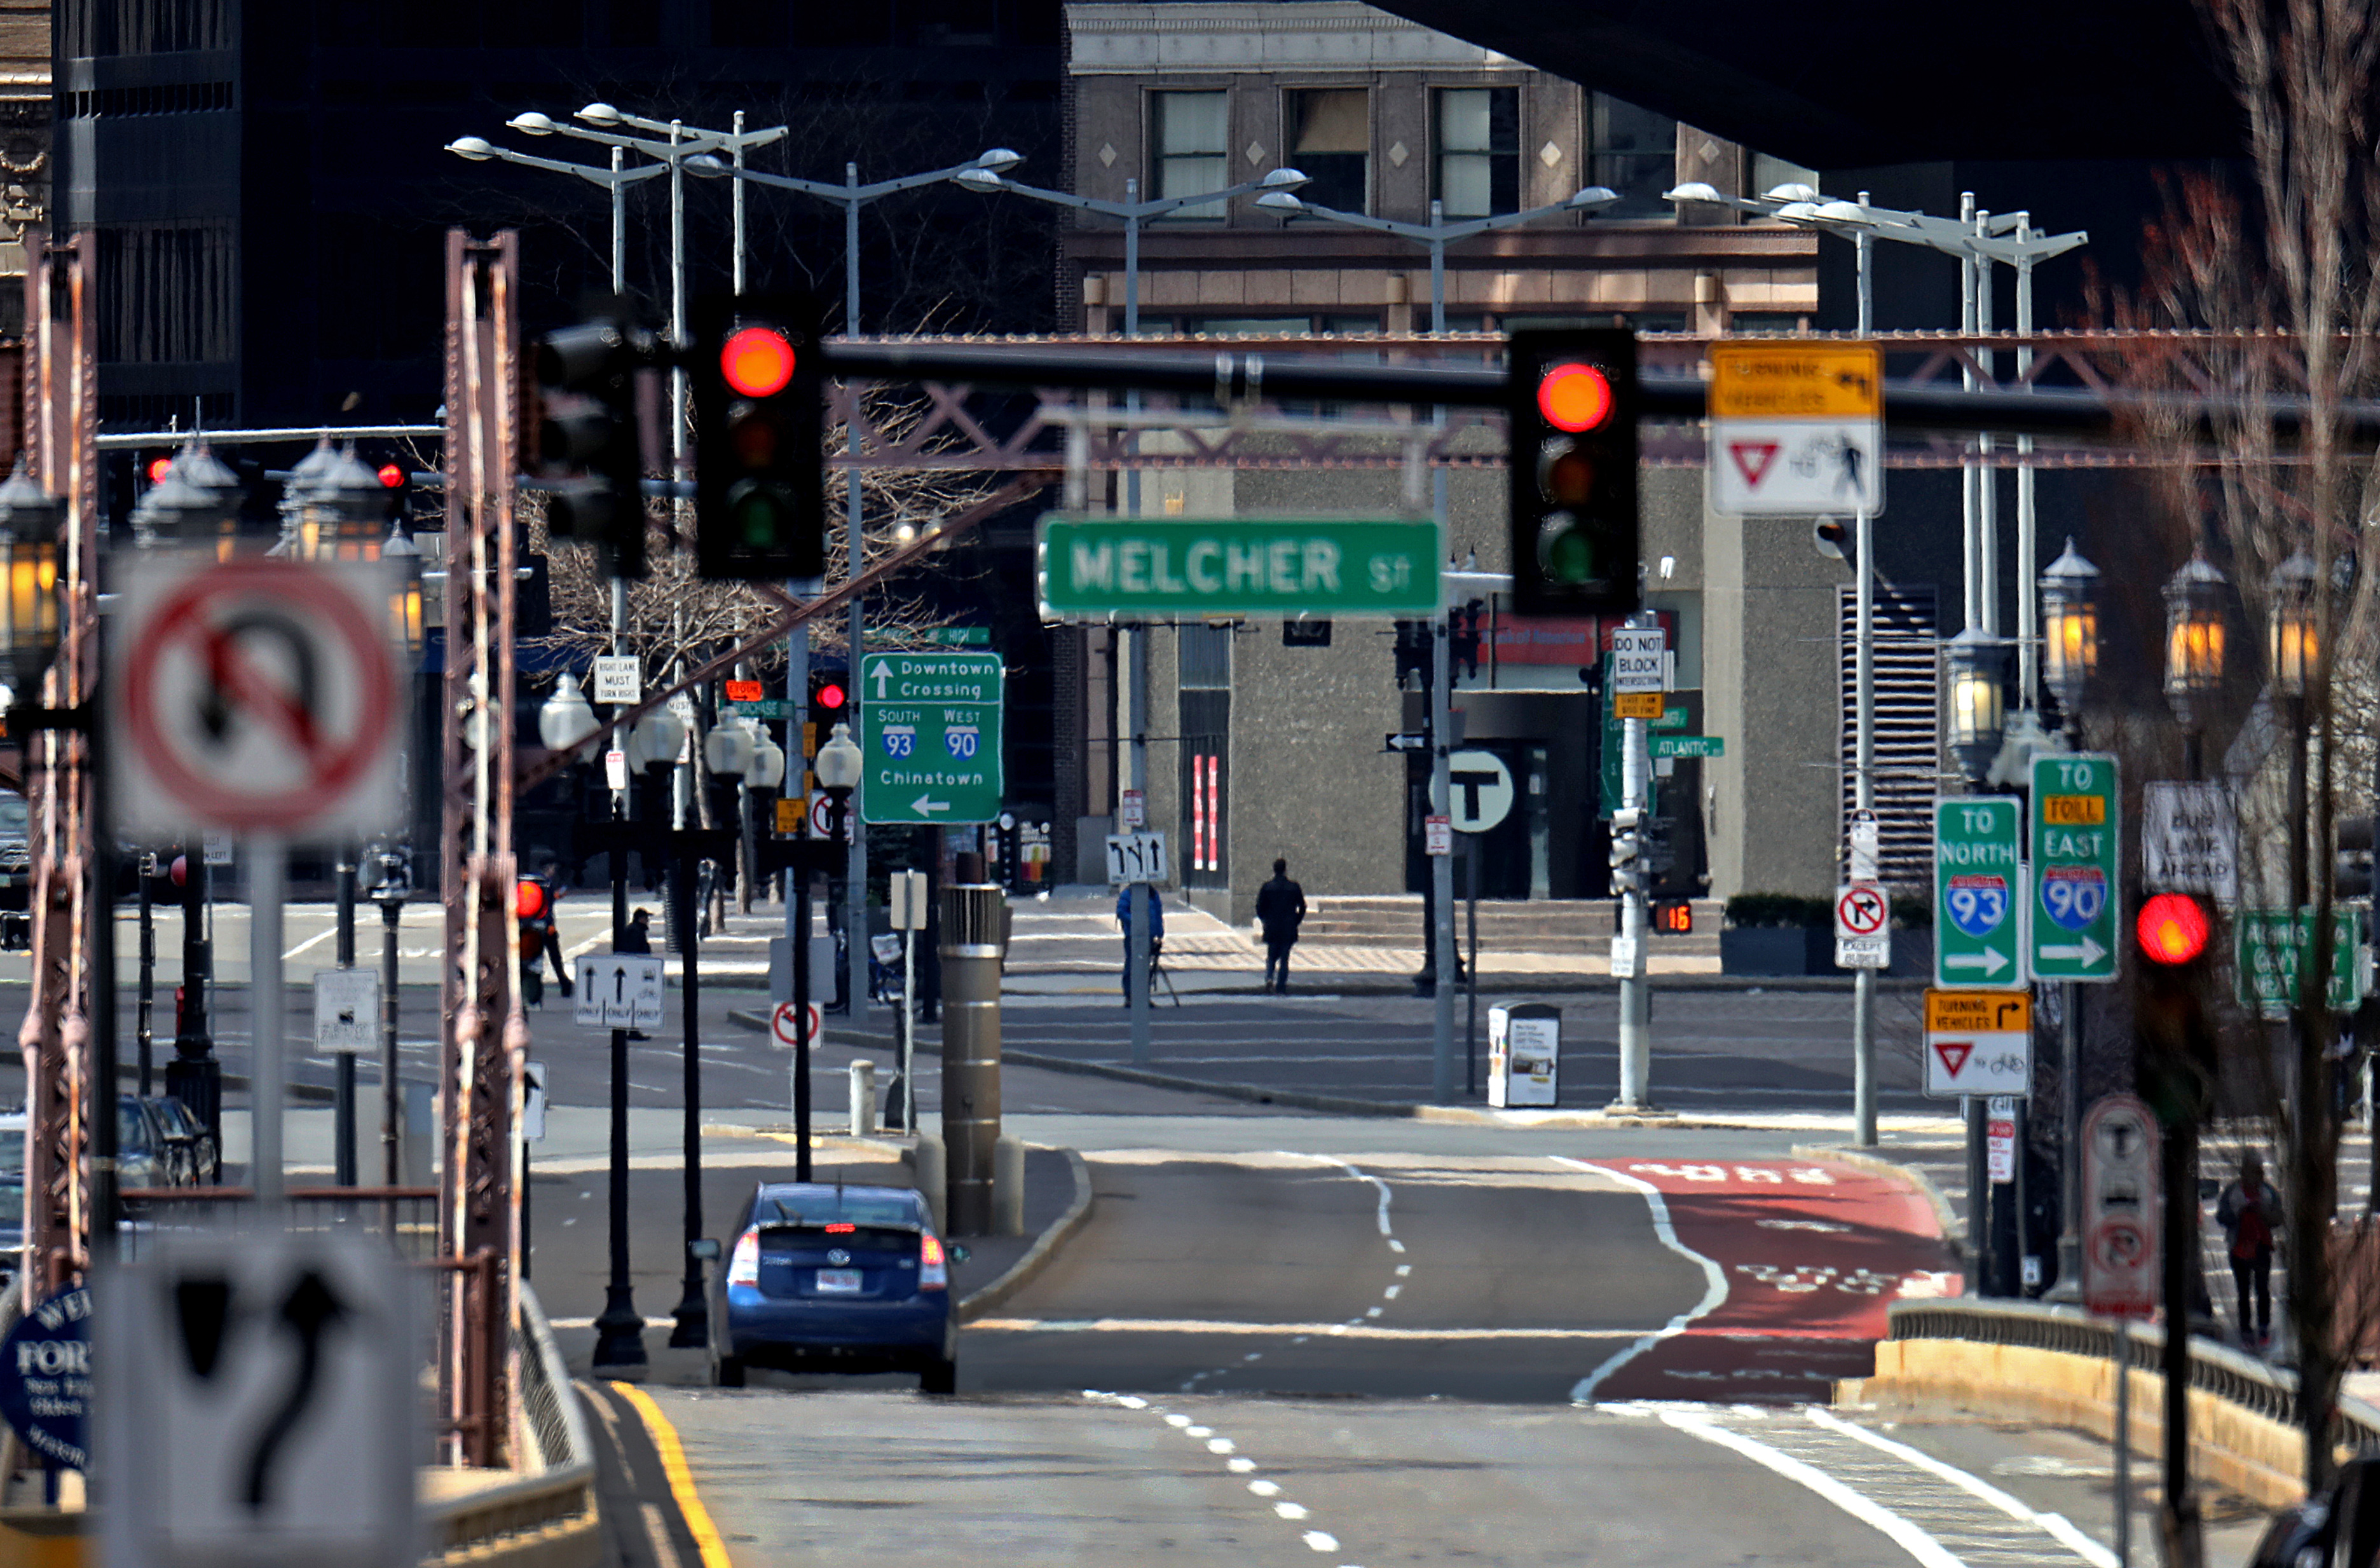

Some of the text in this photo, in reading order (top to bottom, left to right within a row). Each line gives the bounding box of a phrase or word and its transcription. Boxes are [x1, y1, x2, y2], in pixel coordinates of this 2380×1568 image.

[1071, 538, 1342, 595] MELCHER
[1615, 637, 1661, 651] DO NOT
[901, 661, 994, 675] Downtown
[1619, 658, 1658, 672] BLOCK
[605, 675, 630, 685] MUST
[900, 681, 981, 700] Crossing
[878, 709, 980, 722] SOUTH WEST
[887, 733, 976, 756] 93 90
[1658, 740, 1709, 756] ATLANTIC
[880, 770, 983, 785] Chinatown
[2057, 762, 2093, 791] TO
[1451, 771, 1500, 821] T
[2051, 798, 2094, 820] TOLL
[1960, 808, 1995, 834] TO
[1939, 840, 2015, 865] NORTH
[2044, 830, 2103, 857] EAST
[1951, 889, 2003, 925] 93
[2048, 881, 2100, 919] 90
[1669, 906, 1689, 931] 16
[1938, 999, 1988, 1013] TURNING
[1934, 1016, 1990, 1030] VEHICLES
[17, 1340, 93, 1377] FOR
